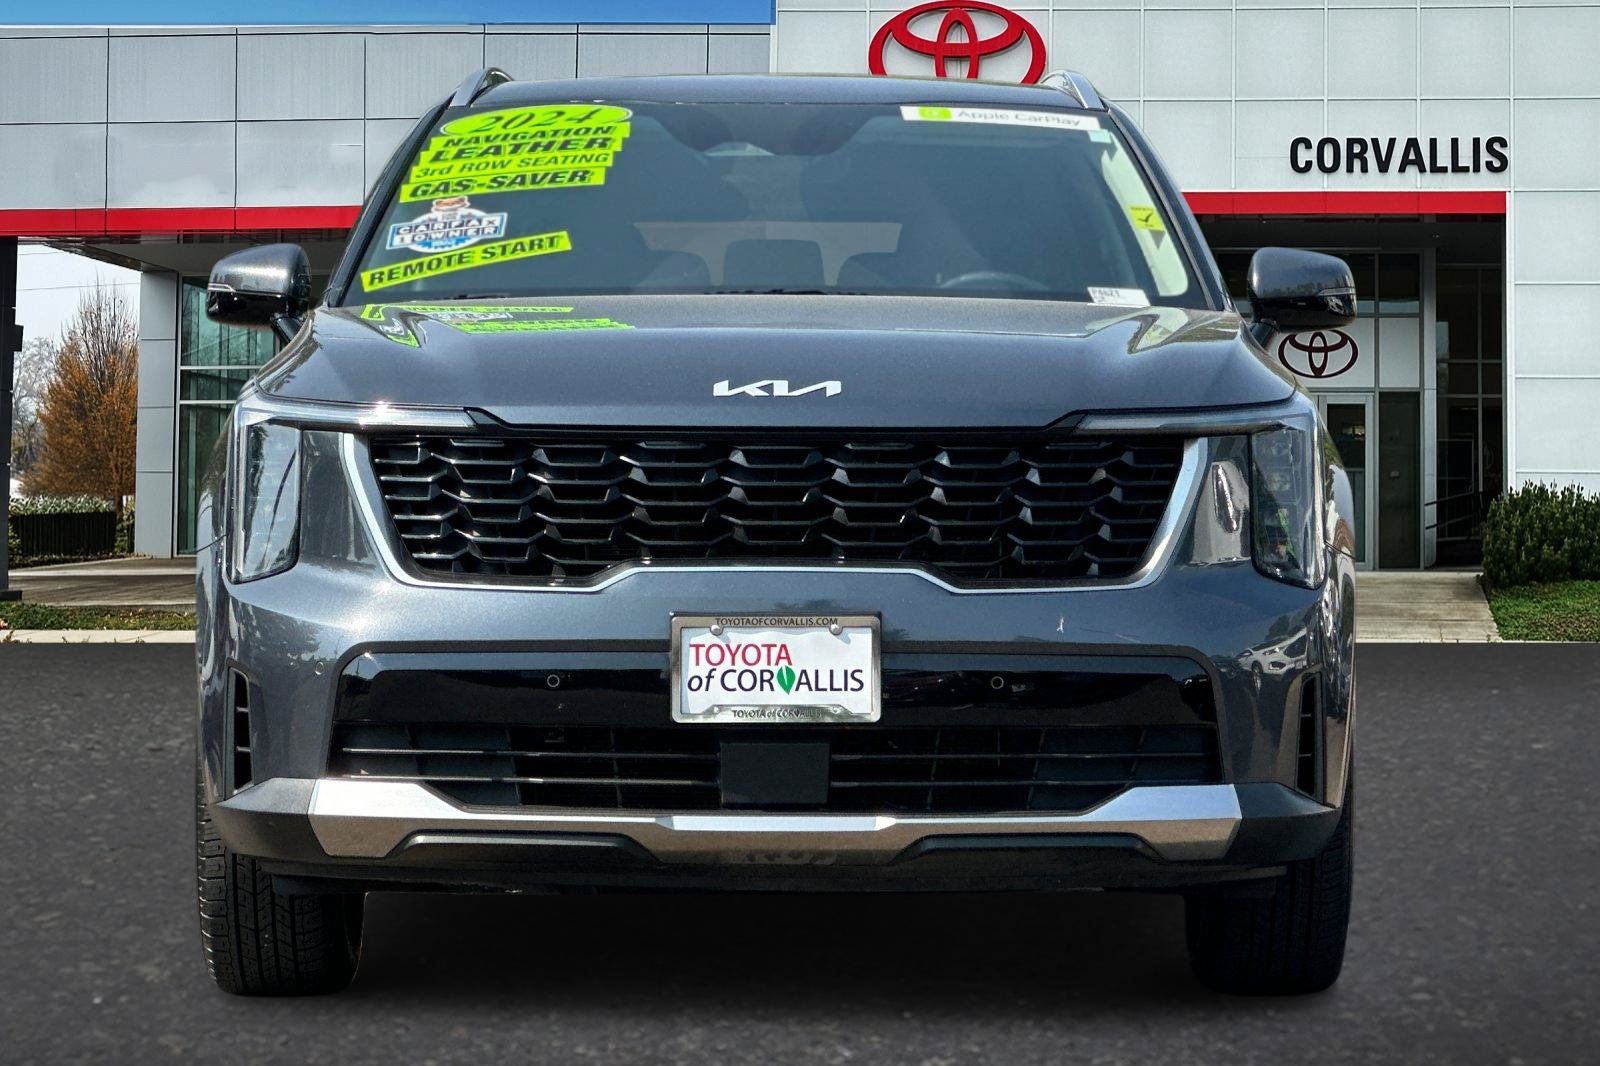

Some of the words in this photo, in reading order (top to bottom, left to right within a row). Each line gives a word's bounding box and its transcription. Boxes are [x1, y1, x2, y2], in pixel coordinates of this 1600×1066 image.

[470, 109, 601, 133] 2024
[958, 109, 1010, 121] Apple
[1013, 113, 1081, 127] CarPlay
[443, 126, 614, 147] NAVIGATION
[428, 136, 613, 163] LEATHER
[1289, 136, 1509, 173] CORVALLIS
[414, 165, 452, 179] 3rd
[458, 159, 513, 174] ROW
[517, 152, 610, 169] SEATING
[410, 169, 591, 198] GAS-SAVER
[368, 250, 476, 287] REMOTE
[481, 235, 560, 259] START
[715, 617, 838, 626] TOYOTAOFCORVALLIS.COM
[689, 643, 793, 667] TOYOTA
[687, 668, 716, 692] of
[732, 709, 766, 718] TOYOTA
